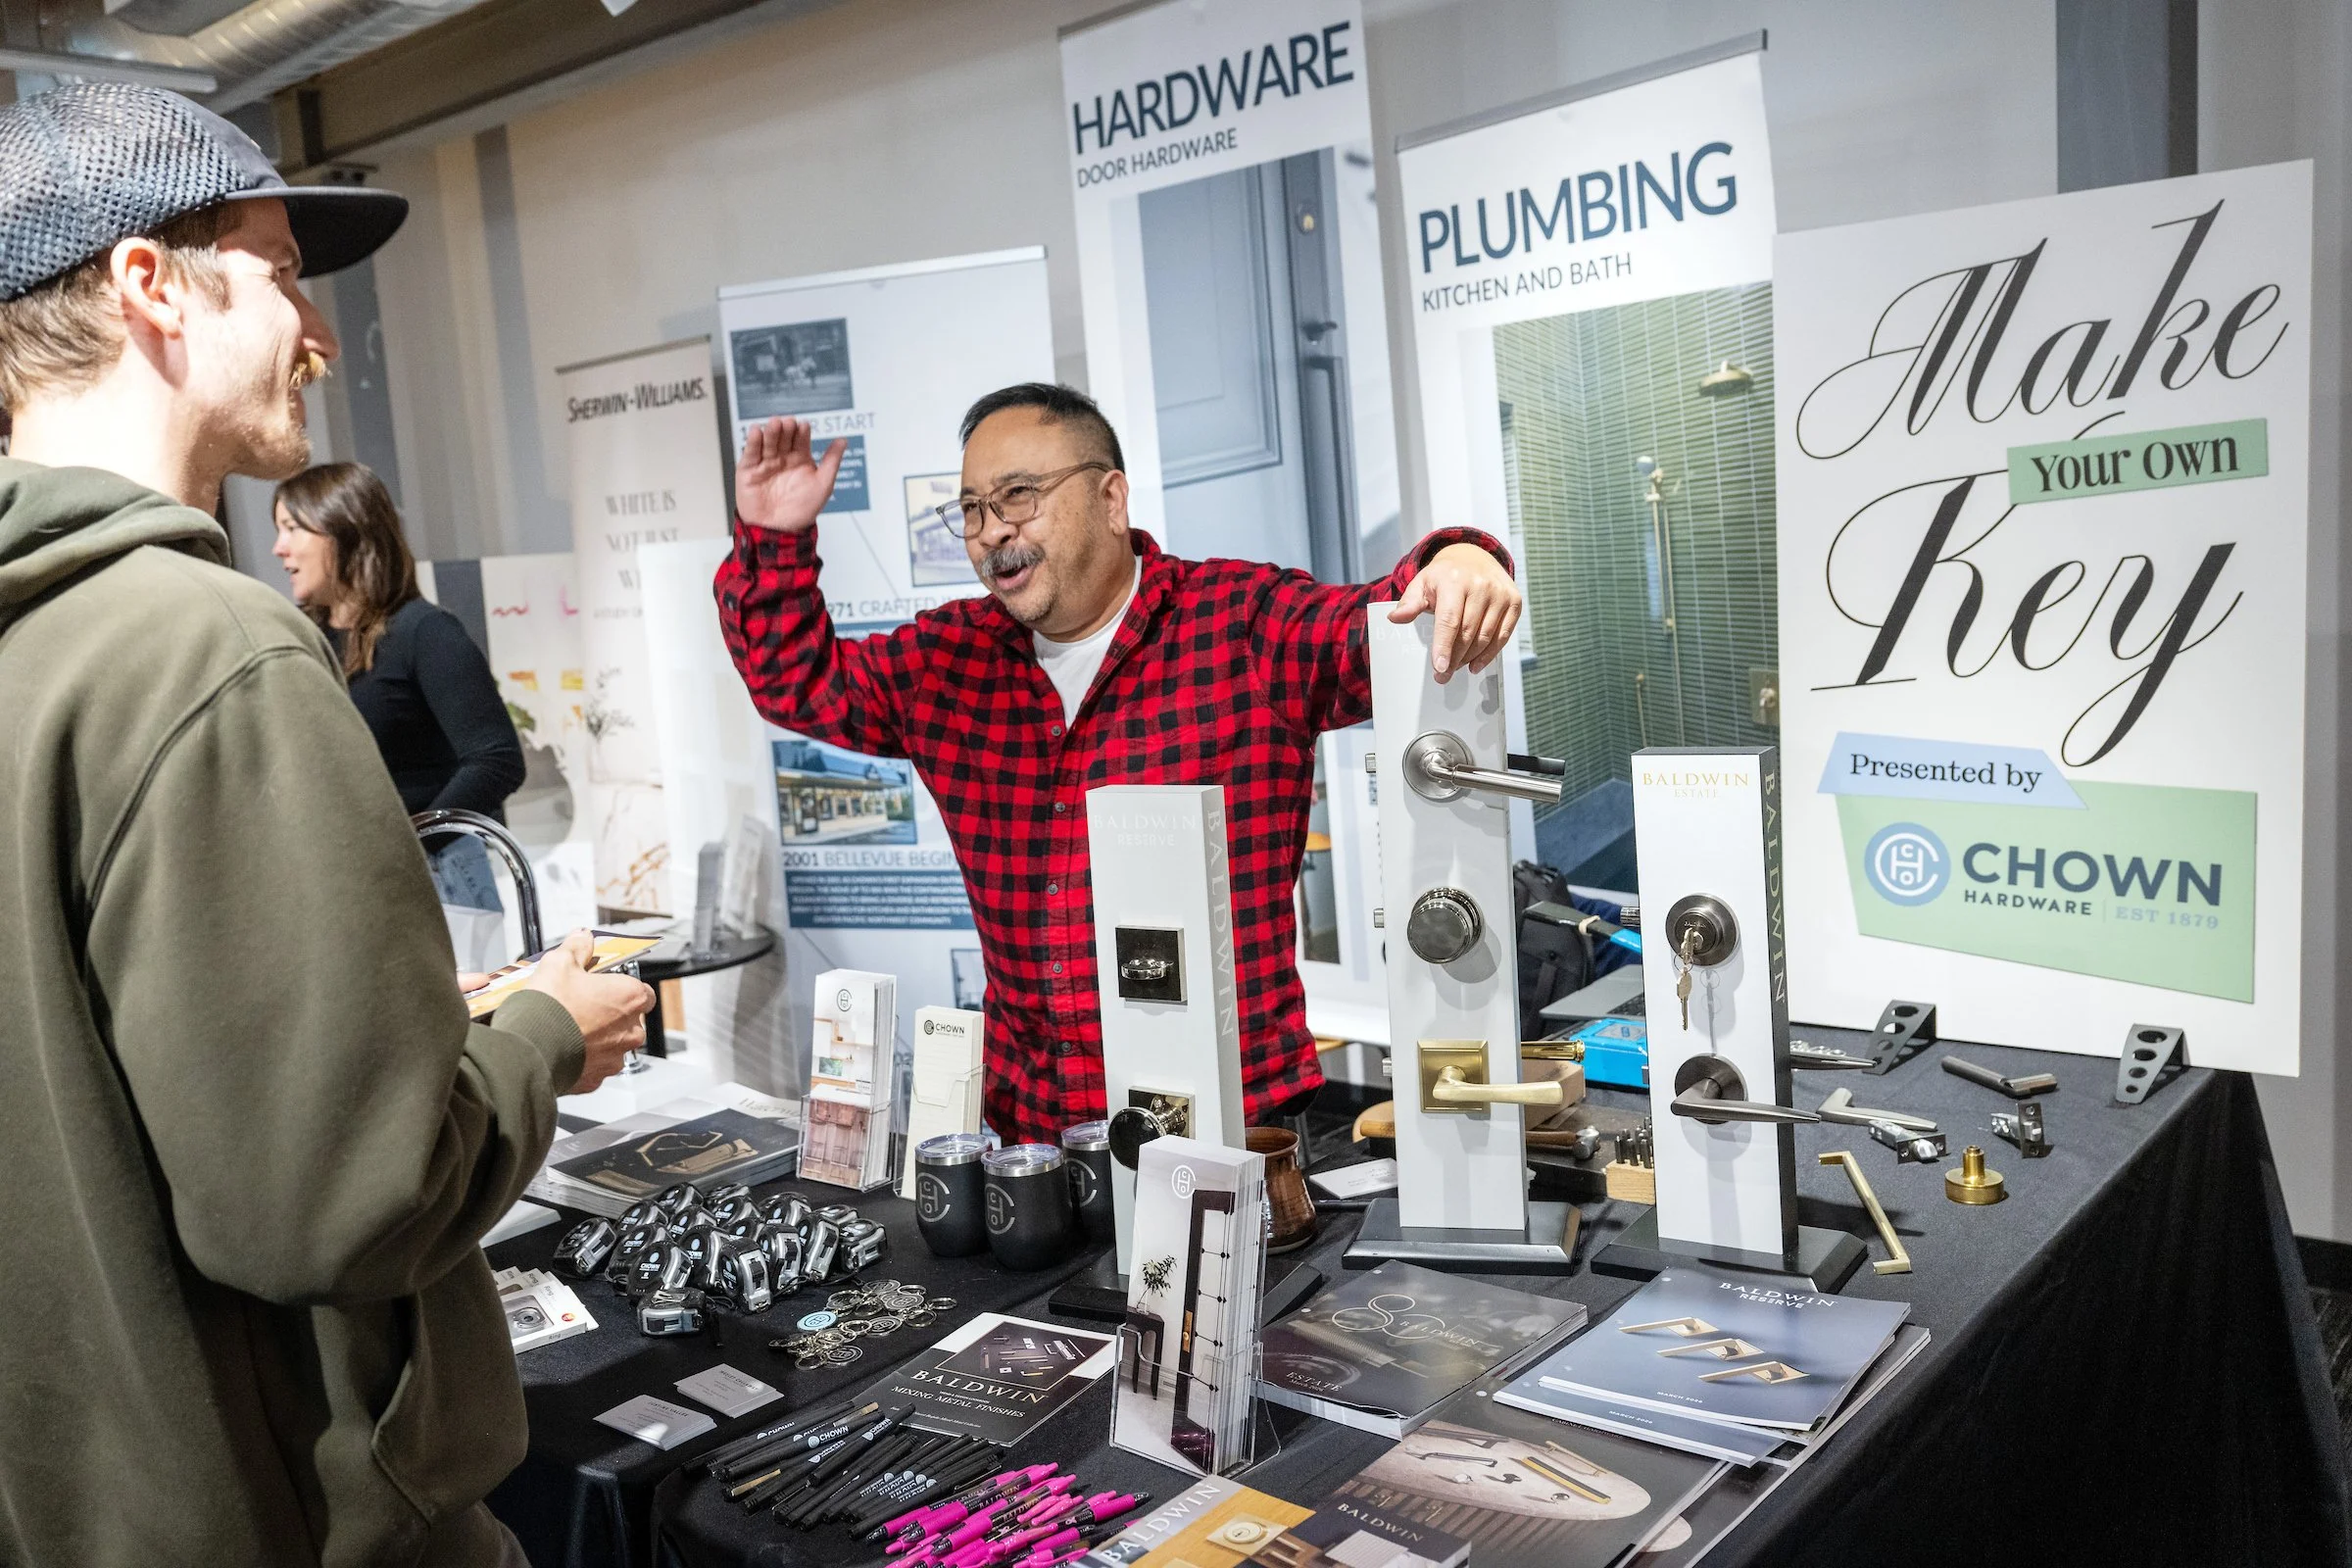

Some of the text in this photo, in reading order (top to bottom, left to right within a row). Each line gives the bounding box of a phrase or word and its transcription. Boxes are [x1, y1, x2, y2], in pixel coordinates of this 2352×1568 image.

[1073, 21, 1355, 156] HARDWARE
[1077, 127, 1239, 189] DOOR HARDWARE
[1419, 141, 1739, 274] PLUMBING
[1422, 252, 1634, 314] KITCHEN AND BATH
[1796, 198, 2290, 461] Make
[825, 412, 876, 432] START
[2031, 434, 2239, 493] Your Own
[827, 602, 854, 617] 971
[858, 597, 936, 617] CRAFTED
[1811, 468, 2244, 767] Key
[1375, 624, 1435, 640] BALD
[1642, 771, 1749, 786] BALDWIN
[1849, 753, 2043, 793] Presented by
[1675, 789, 1719, 798] ESTATE
[1093, 813, 1197, 830] BALDWIN
[1117, 834, 1176, 847] RESERVE
[783, 852, 819, 867] 2001
[824, 851, 905, 867] BELLEVUE
[1962, 842, 2223, 906] CHOWN
[1764, 769, 1786, 1004] BALDWIN
[1207, 809, 1236, 1038] BALDWIN
[1964, 890, 2220, 930] HARDWARE EST 1879
[935, 1023, 965, 1034] CHOWN
[1719, 1282, 1838, 1307] BALDWIN
[1740, 1294, 1805, 1309] RESERVE
[910, 1369, 1050, 1404] BALDWIN
[1287, 1371, 1343, 1393] ESTATE
[1657, 1391, 1684, 1399] MARCH
[891, 1386, 934, 1400] MIXING
[935, 1396, 972, 1408] METAL
[975, 1403, 1026, 1418] FINISHES
[1608, 1410, 1634, 1420] MARCH
[819, 1426, 849, 1442] CHOWN
[1102, 1484, 1223, 1565] BALDWIN
[1337, 1502, 1425, 1544] BALDWIN
